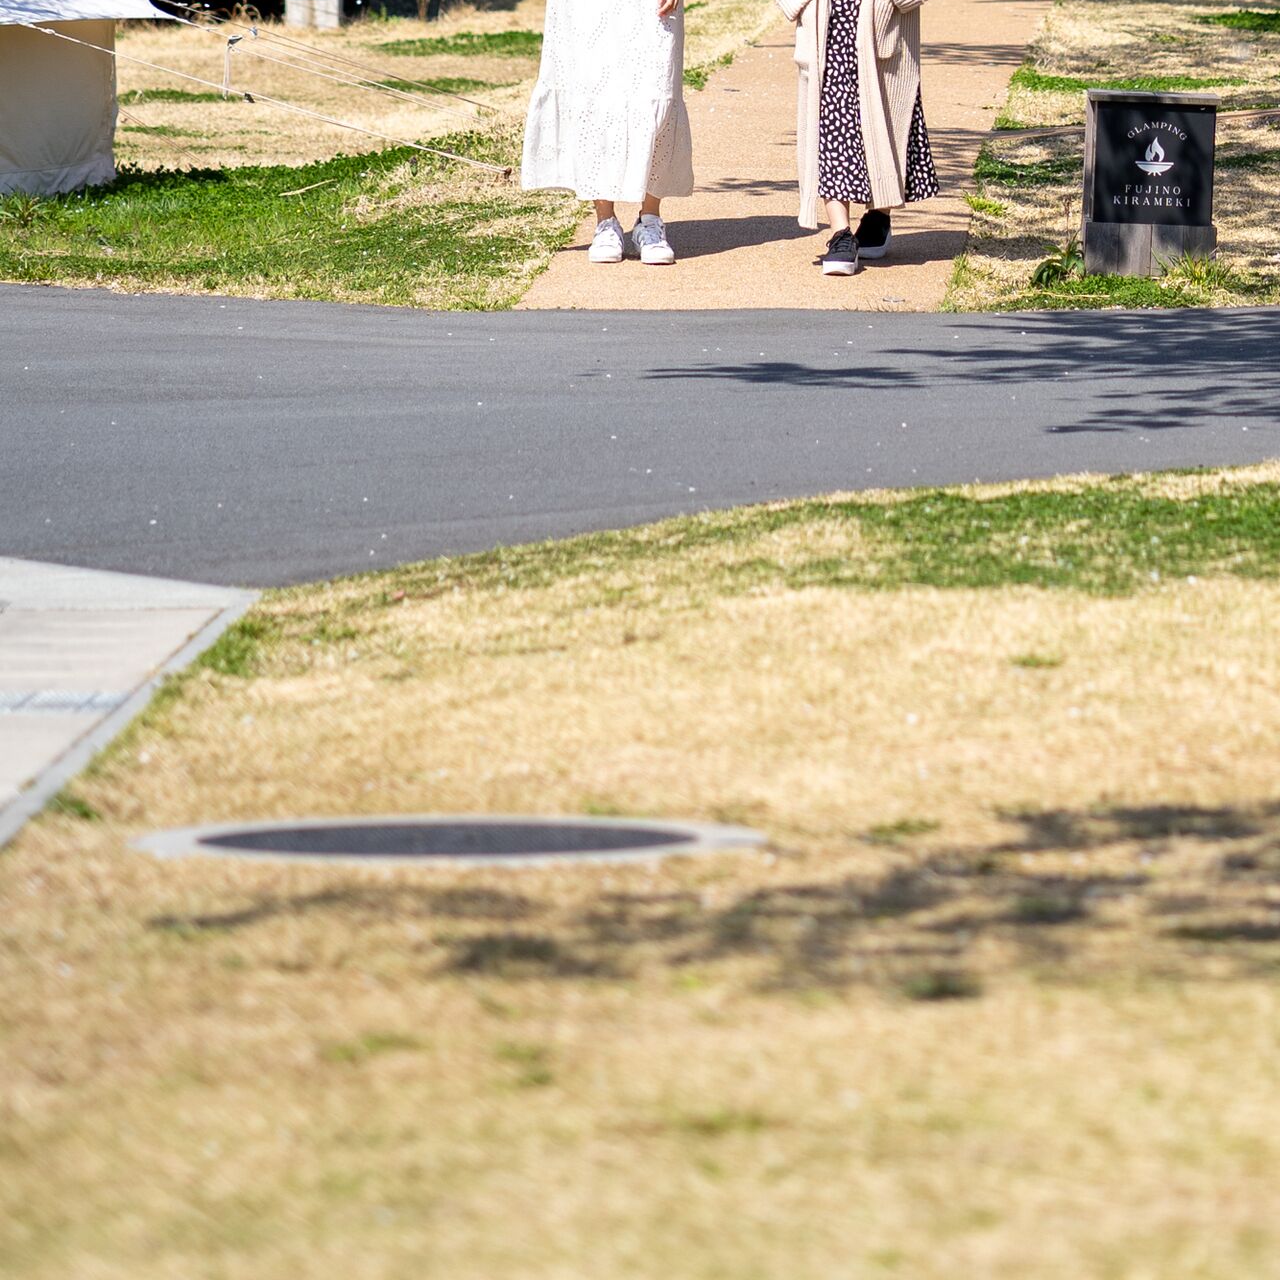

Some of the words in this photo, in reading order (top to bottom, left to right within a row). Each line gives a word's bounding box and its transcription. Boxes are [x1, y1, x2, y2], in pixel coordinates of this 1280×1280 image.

[1127, 121, 1188, 141] GLAMPING
[1125, 184, 1181, 195] FUJINO
[1113, 195, 1190, 207] KIRAMEKI
